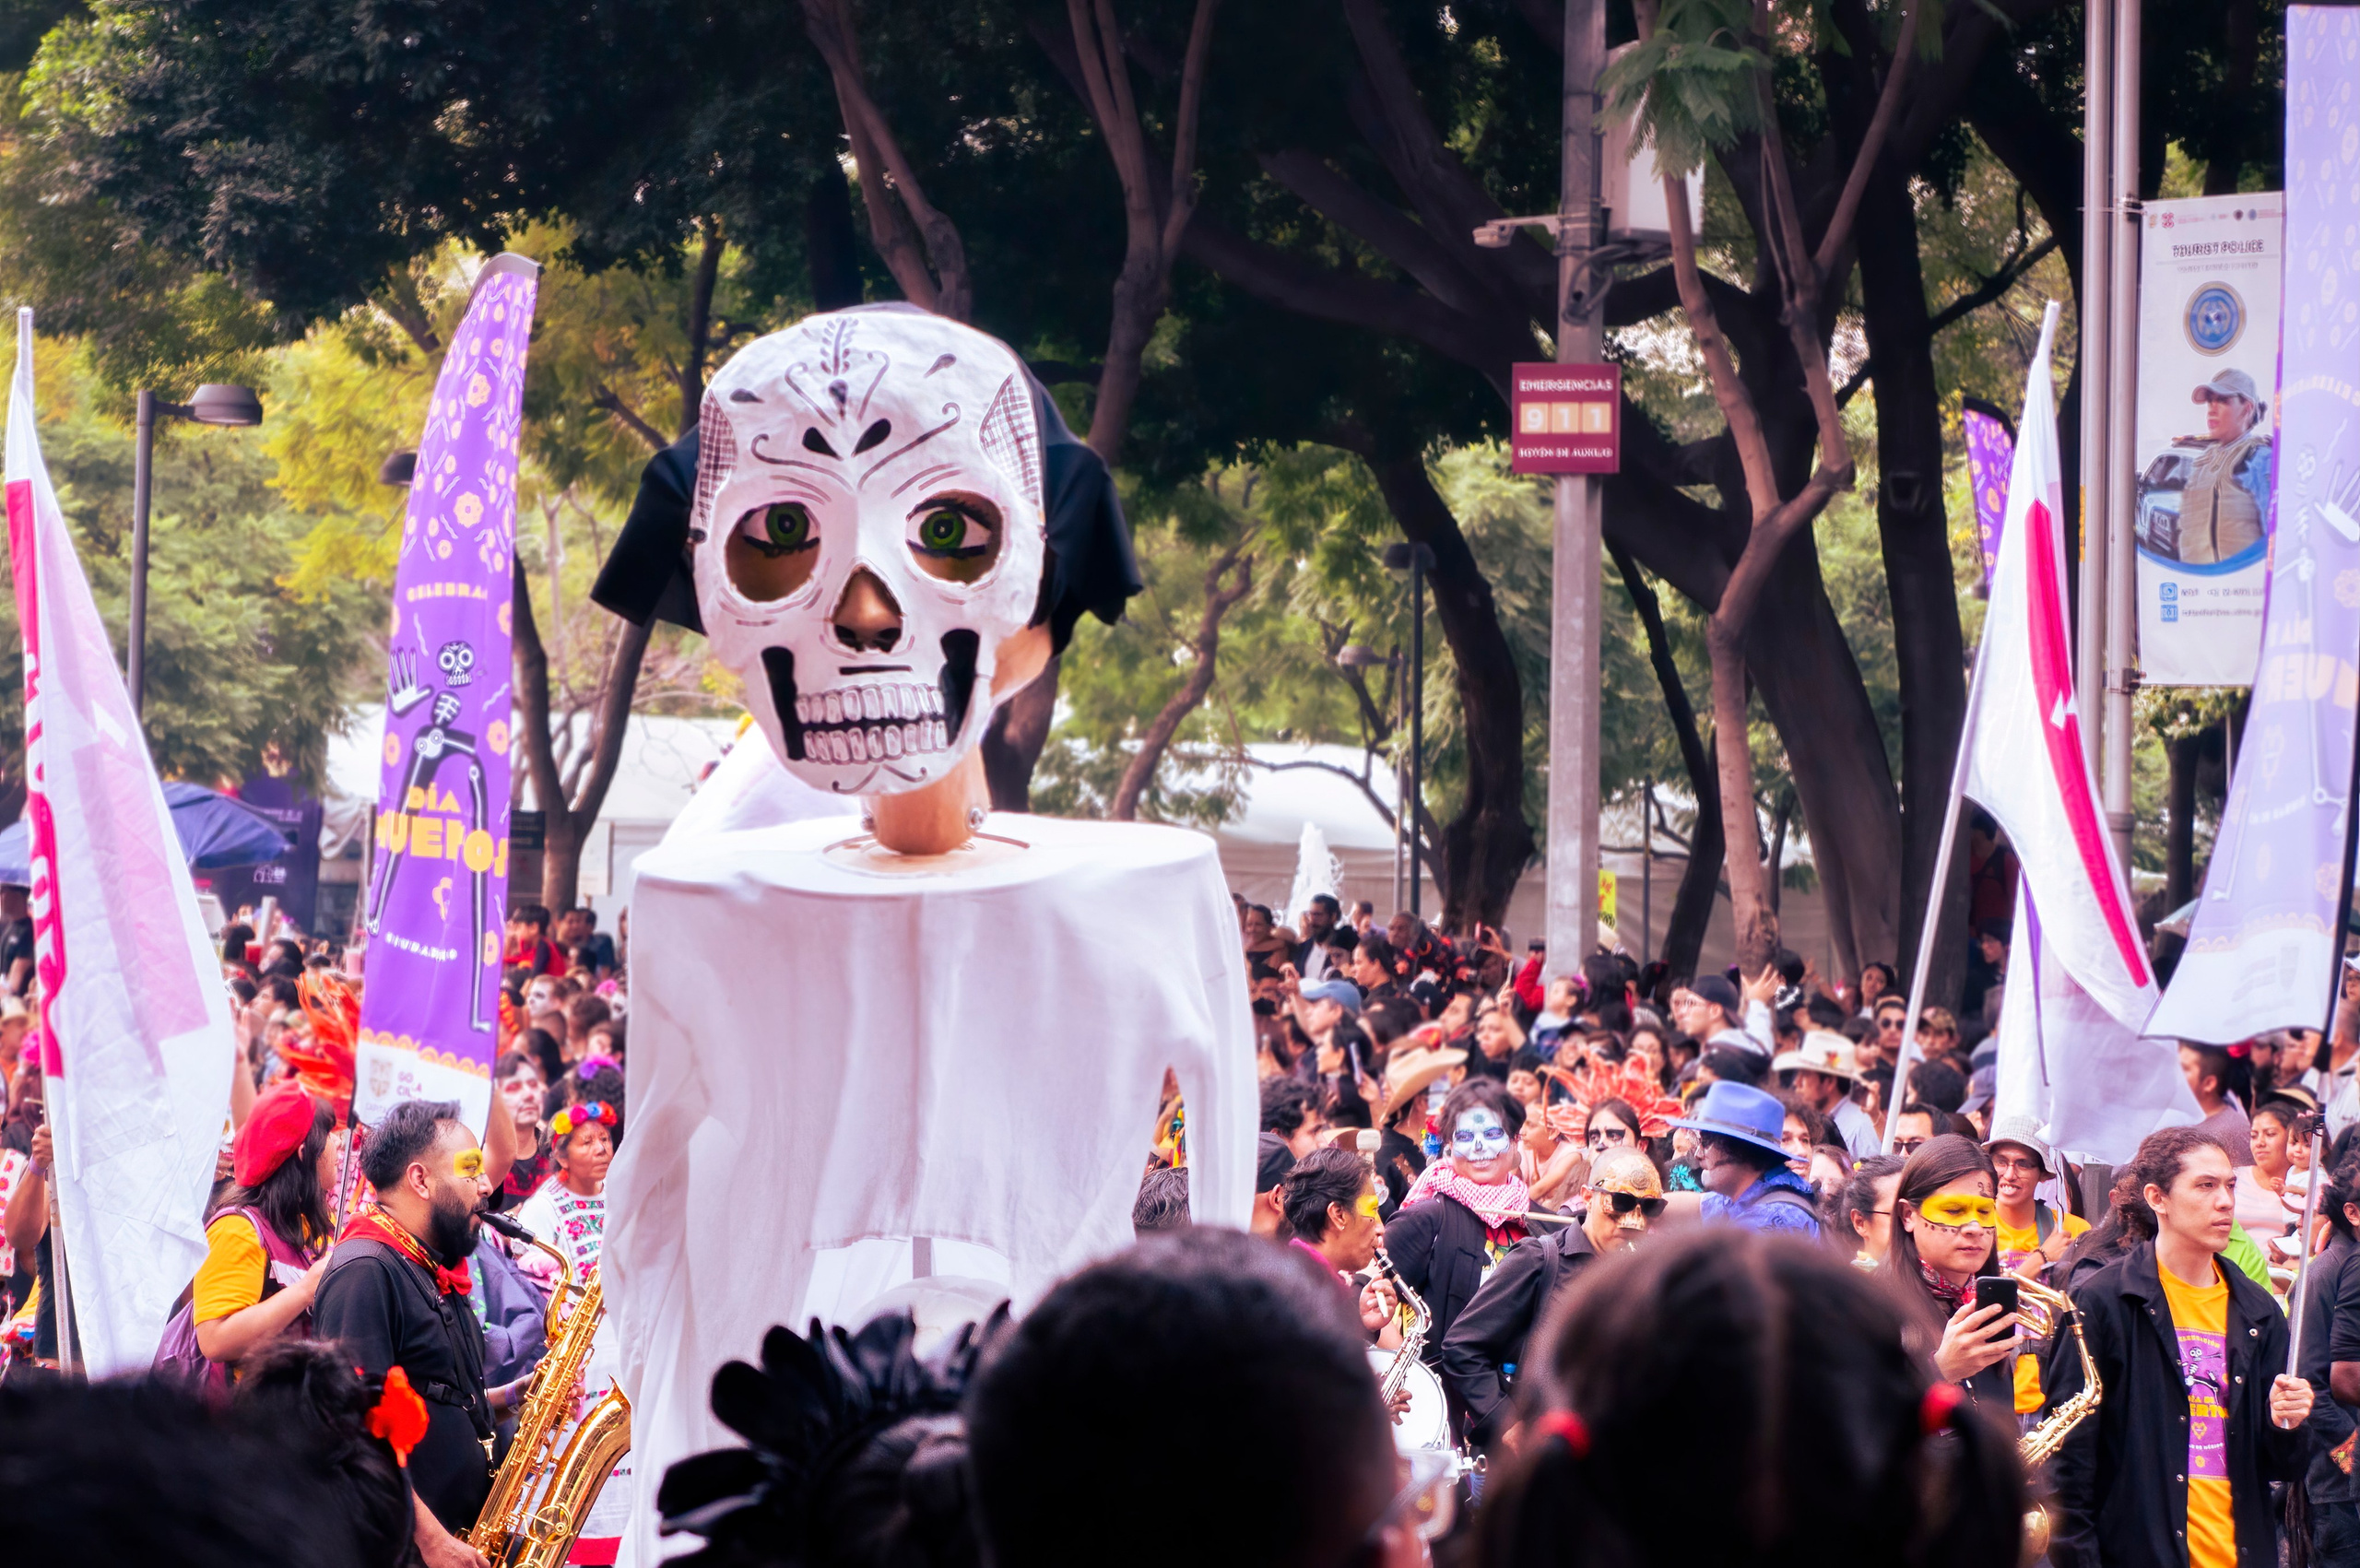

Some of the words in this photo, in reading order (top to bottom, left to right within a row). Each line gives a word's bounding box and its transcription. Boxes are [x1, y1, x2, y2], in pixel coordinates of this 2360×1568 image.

[2221, 239, 2264, 254] POLICE
[1519, 379, 1613, 392] EMERGENCIAS
[1527, 407, 1602, 430] 911
[407, 782, 461, 813] DÍA
